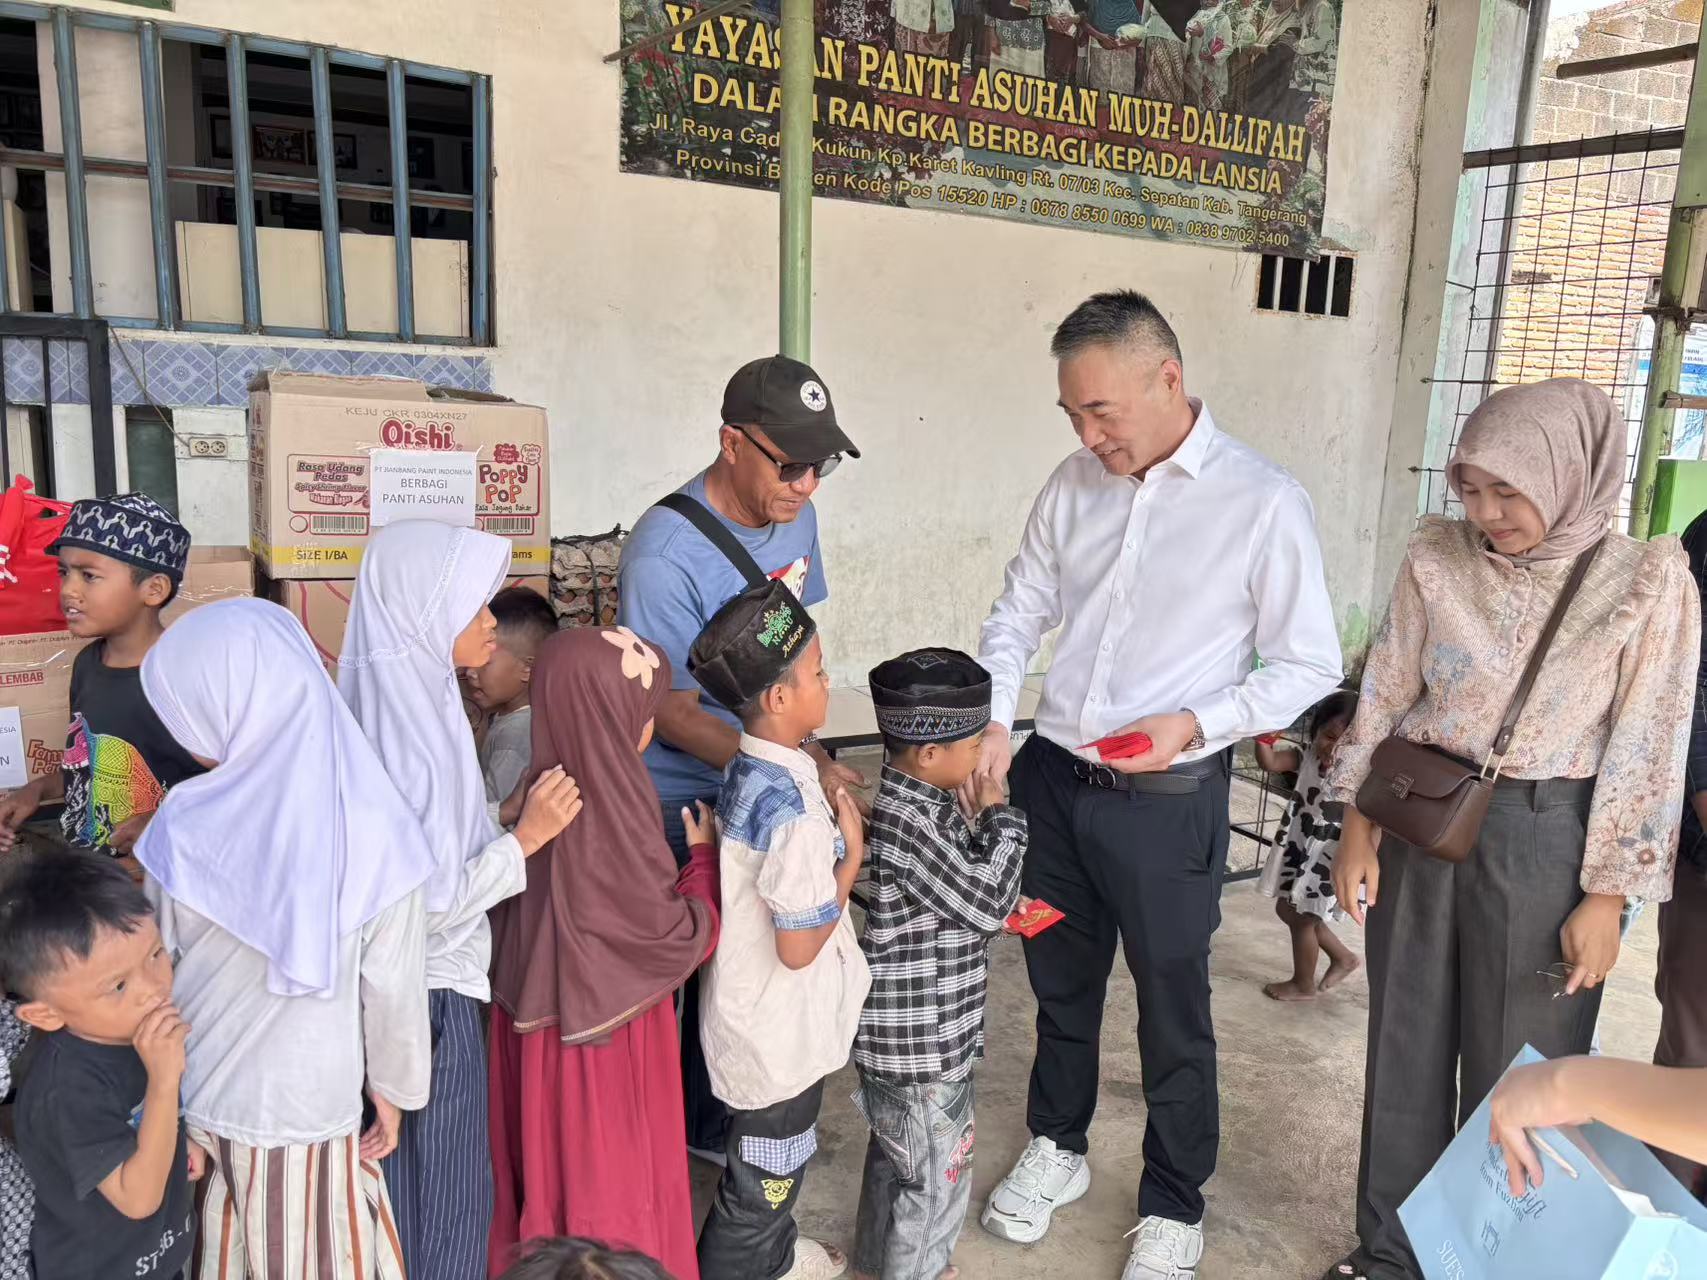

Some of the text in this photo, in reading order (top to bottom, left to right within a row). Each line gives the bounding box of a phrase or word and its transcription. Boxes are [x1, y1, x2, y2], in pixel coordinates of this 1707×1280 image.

[665, 3, 1305, 162] YAYAN PANTI ASUHAN MUH-DALLIFAH
[693, 72, 1282, 195] DALA RANGKA BERBAGI KEPADA LANSIA
[650, 113, 674, 131] Jl.
[682, 118, 733, 142] Raya
[812, 137, 871, 160] Kukun
[962, 159, 1027, 187] Kavling
[1032, 169, 1054, 188] Rt.
[1059, 174, 1099, 195] 07/03
[1104, 181, 1135, 200] Kec.
[1141, 188, 1200, 210] Sepatan
[1203, 197, 1233, 215] Kab.
[1238, 201, 1307, 227] Tangerang
[676, 149, 762, 177] Provinsi
[844, 173, 892, 194] Kode
[898, 179, 932, 200] Pos
[938, 185, 988, 206] 15520
[992, 192, 1017, 211] HP
[1031, 199, 1069, 219] 0878
[1072, 204, 1109, 224] 8550
[1112, 209, 1147, 229] 0699
[1151, 217, 1175, 233] WA
[1186, 220, 1220, 239] 0838
[1221, 225, 1254, 243] 9702
[1260, 230, 1290, 247] 5400
[345, 407, 378, 417] KEJU
[382, 409, 410, 419] CKR
[380, 417, 456, 450] Oishi
[382, 493, 465, 505] PANTI ASUHAN
[400, 478, 448, 489] BERBAGI
